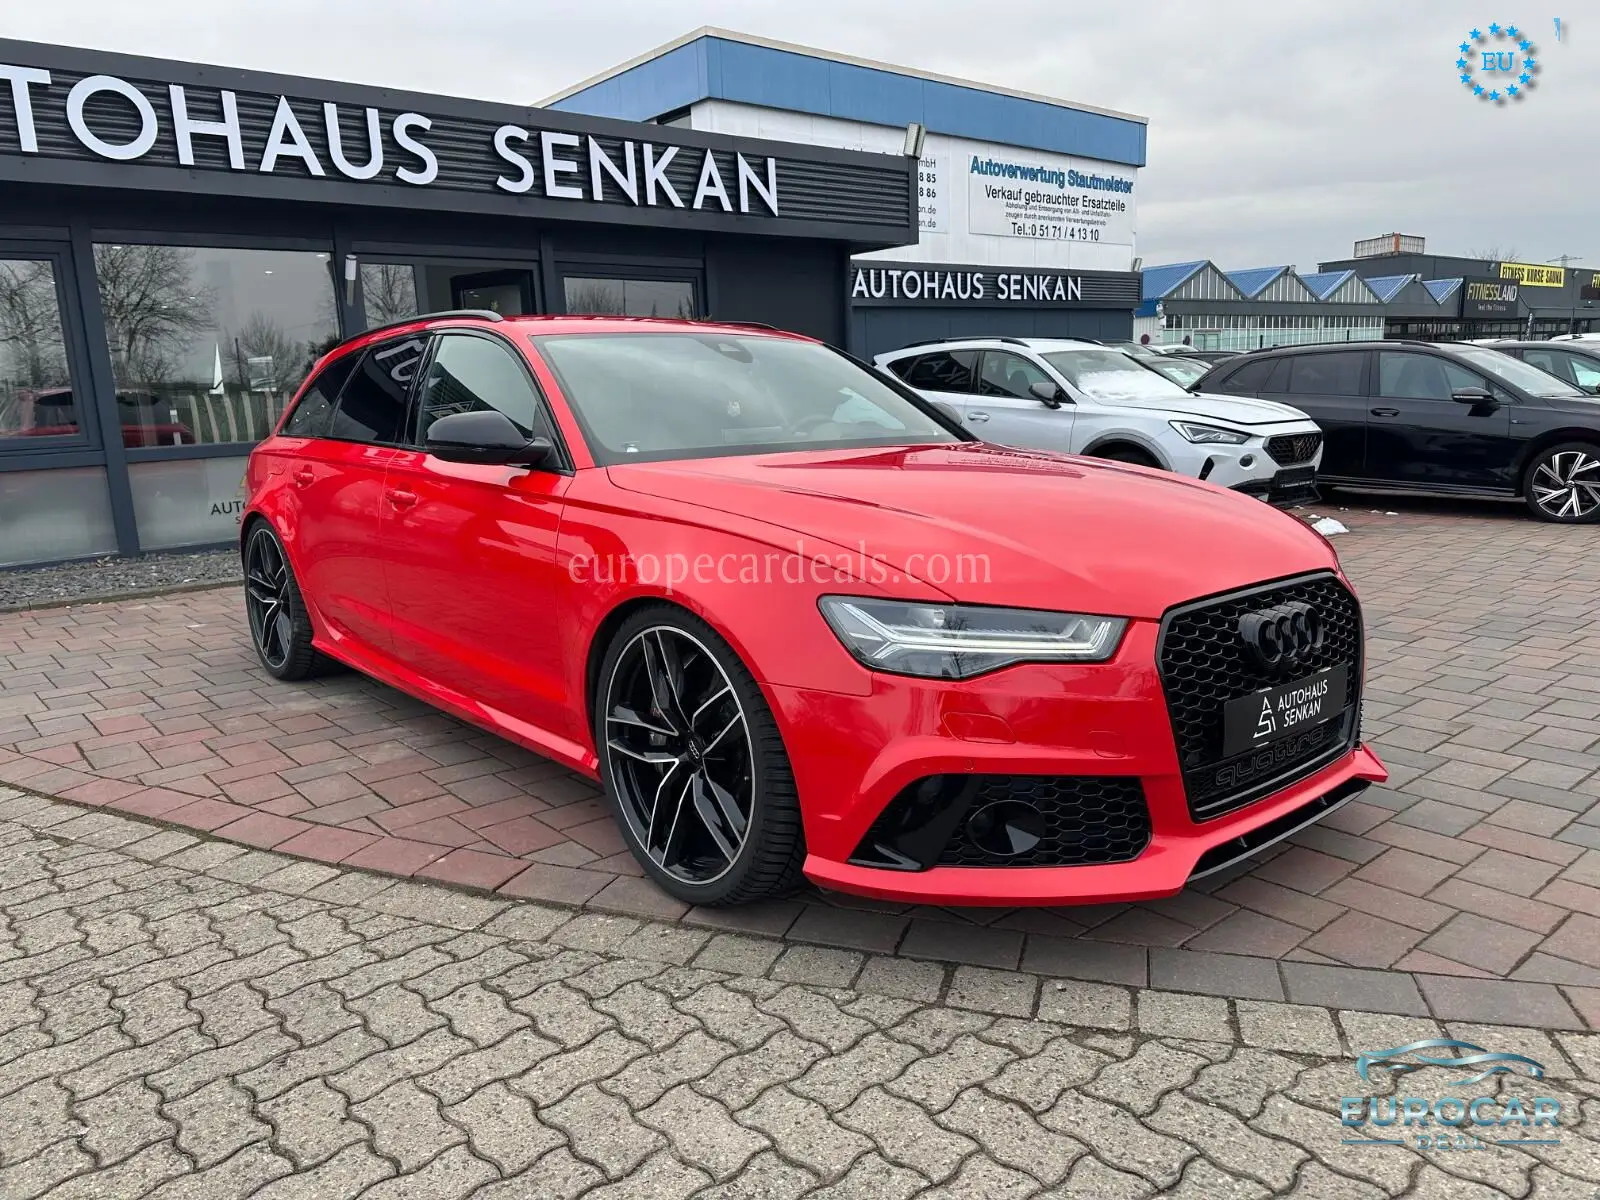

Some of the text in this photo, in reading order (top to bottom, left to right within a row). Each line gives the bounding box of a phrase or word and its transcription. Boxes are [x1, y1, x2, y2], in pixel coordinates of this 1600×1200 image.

[493, 124, 779, 217] SENKAN
[926, 173, 936, 183] 85
[970, 156, 1066, 189] Autoverwertung
[926, 188, 936, 198] 86
[985, 184, 1125, 212] Verkauf gebrauchter Ersatzteile
[1039, 225, 1049, 237] 51
[1052, 226, 1061, 238] 71
[1070, 227, 1075, 239] 4
[1078, 228, 1087, 240] 13
[1090, 228, 1099, 241] 10
[851, 268, 1082, 300] AUTOHAUS SENKAN
[1467, 283, 1518, 301] FITNESSLAND
[1277, 679, 1328, 712] AUTOHAUS
[1283, 698, 1321, 728] SENKAN
[1214, 727, 1326, 786] quattro
